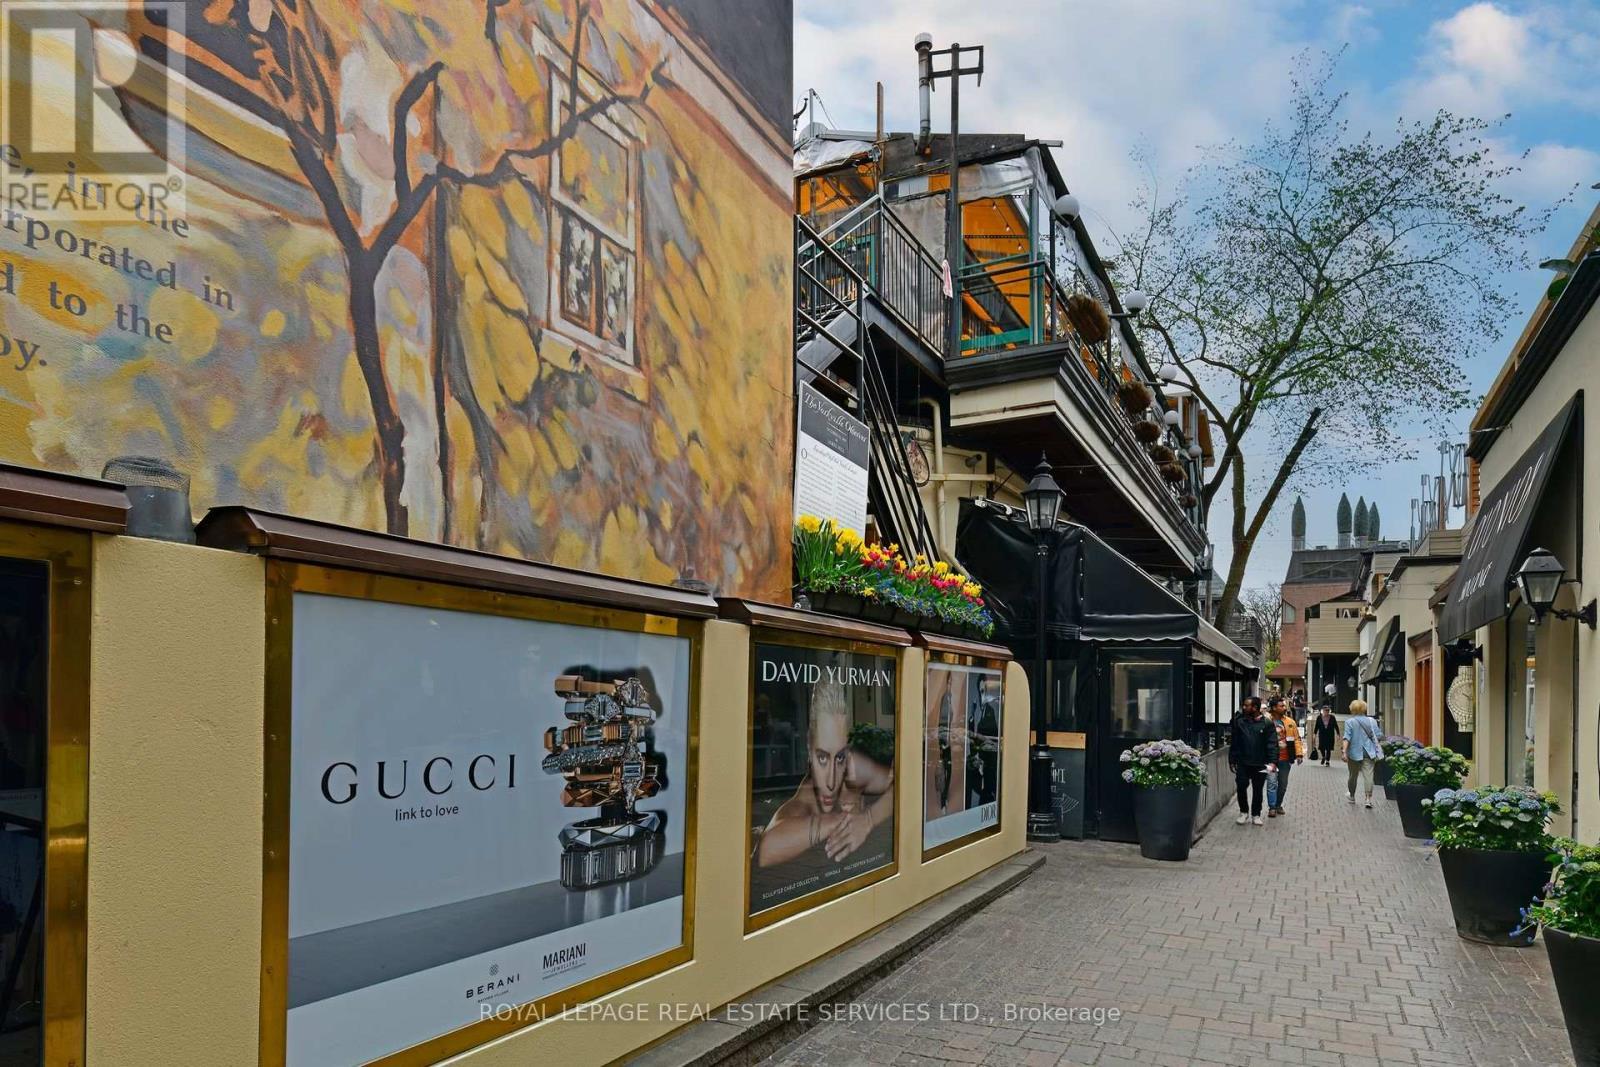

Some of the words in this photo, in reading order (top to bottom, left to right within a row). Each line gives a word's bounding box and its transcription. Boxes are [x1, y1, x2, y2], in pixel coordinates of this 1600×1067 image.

[65, 161, 105, 206] in
[135, 193, 189, 238] the
[203, 276, 235, 312] in
[48, 281, 87, 316] to
[115, 304, 173, 344] the
[762, 660, 821, 684] DAVID
[826, 664, 891, 687] YURMAN
[320, 753, 516, 805] GUCCI
[395, 807, 417, 822] link
[420, 807, 433, 819] to
[435, 804, 459, 817] love
[542, 943, 587, 970] MARIANI
[466, 973, 520, 999] BERANI
